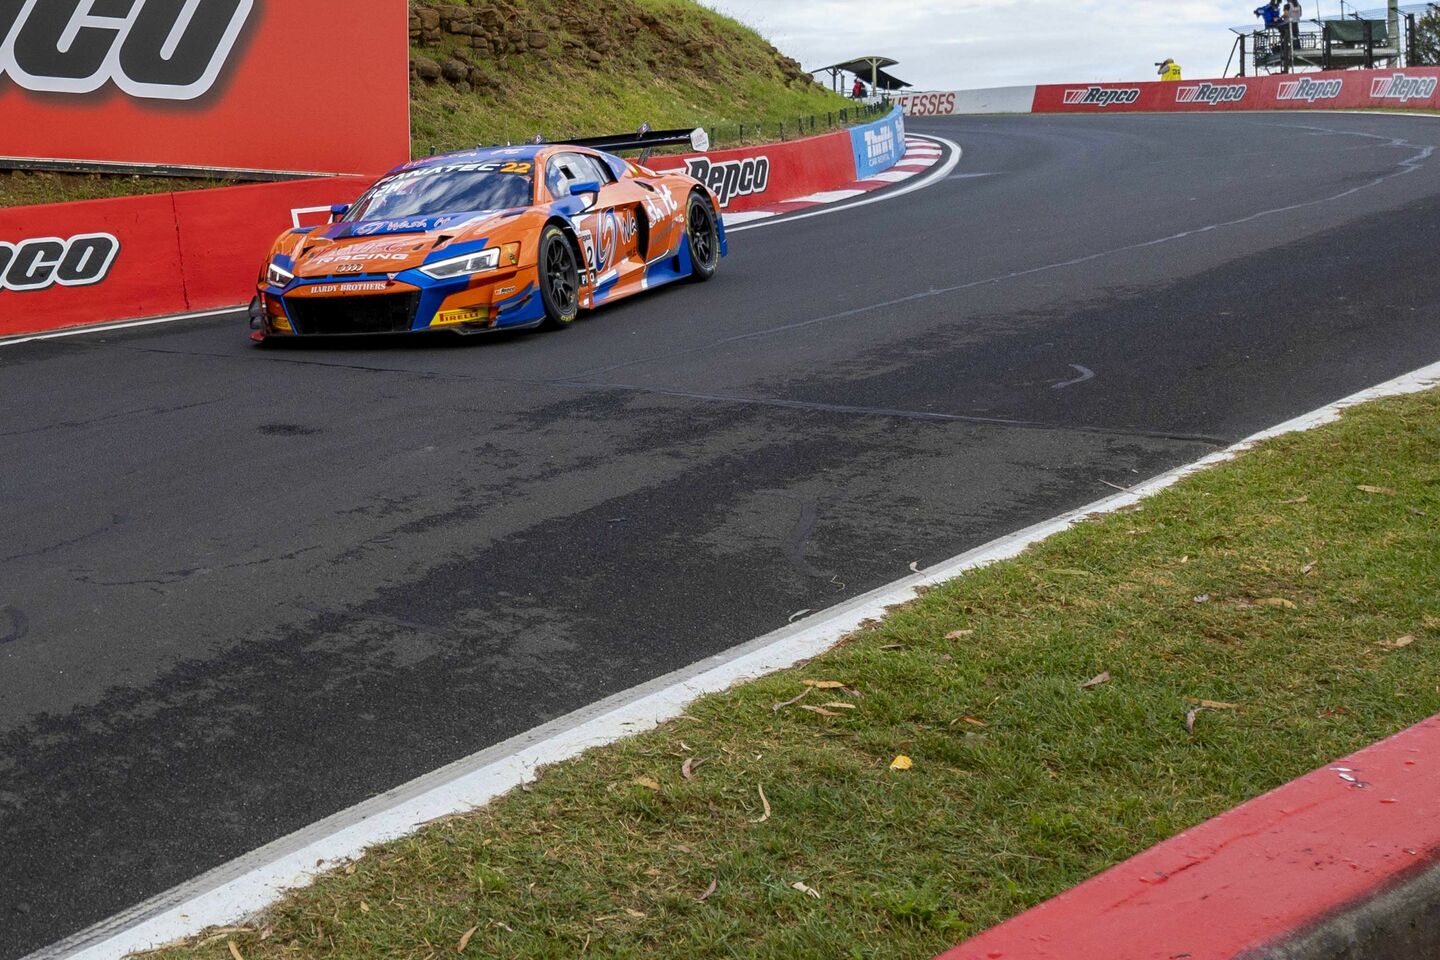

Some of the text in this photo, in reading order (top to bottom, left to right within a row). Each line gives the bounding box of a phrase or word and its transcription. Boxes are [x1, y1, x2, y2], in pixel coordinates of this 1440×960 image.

[1081, 87, 1140, 107] Repco
[1195, 83, 1247, 106] Repco
[1294, 77, 1343, 102] Repco
[1387, 73, 1437, 102] Repco
[911, 93, 955, 116] ESSES
[374, 162, 531, 187] FANATEC 22
[684, 156, 769, 208] Repco
[316, 253, 409, 265] RACING
[311, 283, 386, 294] HARDY BROTHERS
[439, 311, 479, 322] PIRELLI
